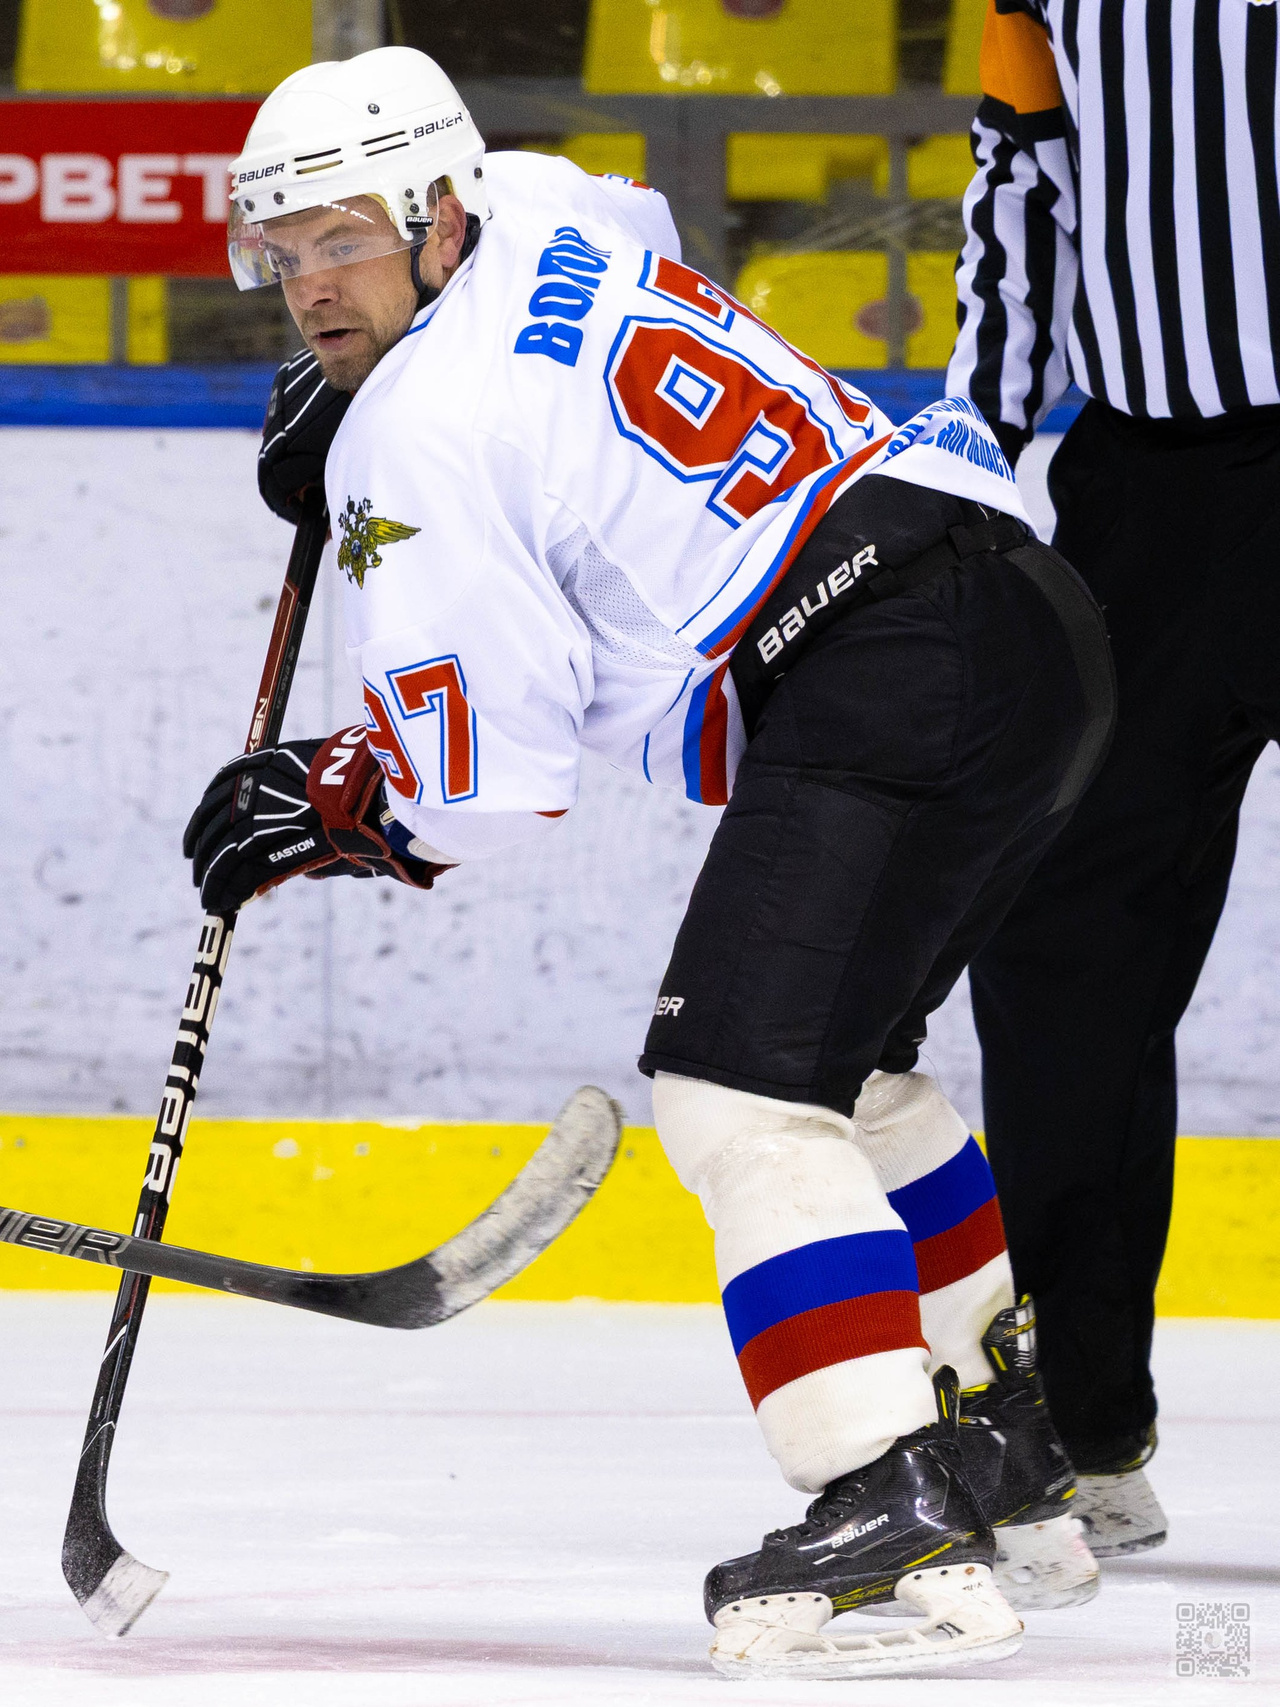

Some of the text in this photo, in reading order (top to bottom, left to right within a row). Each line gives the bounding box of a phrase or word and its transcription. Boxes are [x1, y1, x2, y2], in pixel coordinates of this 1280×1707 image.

[238, 162, 286, 184] BAUER
[406, 216, 434, 225] BAUER
[603, 249, 875, 531] 97
[756, 543, 879, 665] BAUER
[363, 653, 478, 805] 97
[268, 837, 316, 863] EASTON
[141, 914, 236, 1206] BAUER
[831, 1513, 890, 1550] BAUER
